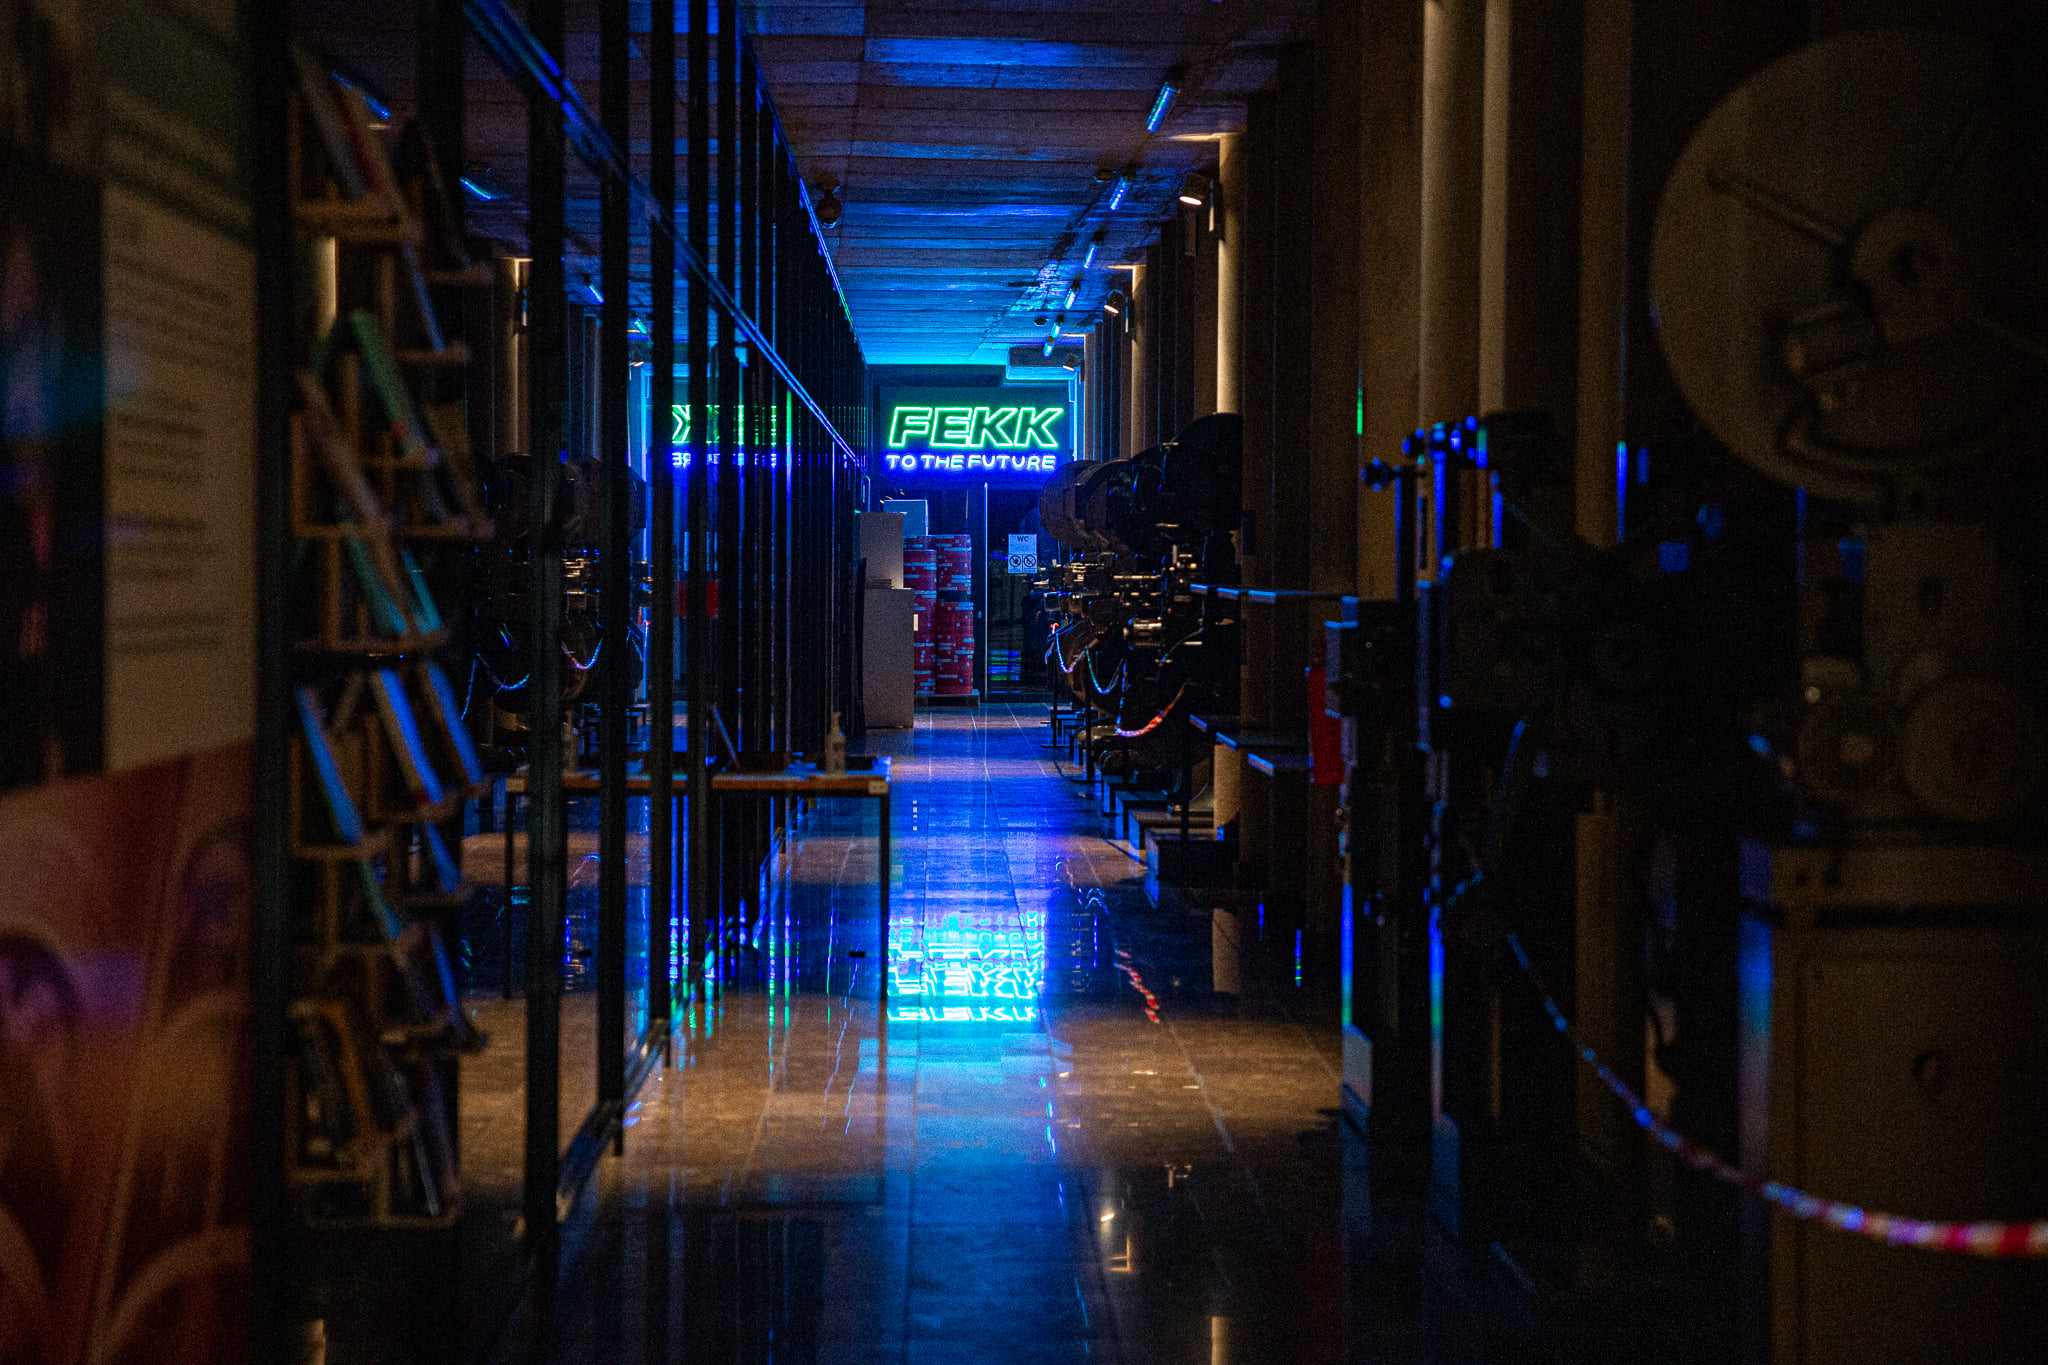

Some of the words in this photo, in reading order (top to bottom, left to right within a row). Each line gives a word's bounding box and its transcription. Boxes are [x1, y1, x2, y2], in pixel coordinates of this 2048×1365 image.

[889, 406, 1064, 447] FEKK
[886, 454, 916, 469] TO
[920, 455, 965, 469] THE
[967, 455, 1056, 470] FUTURE
